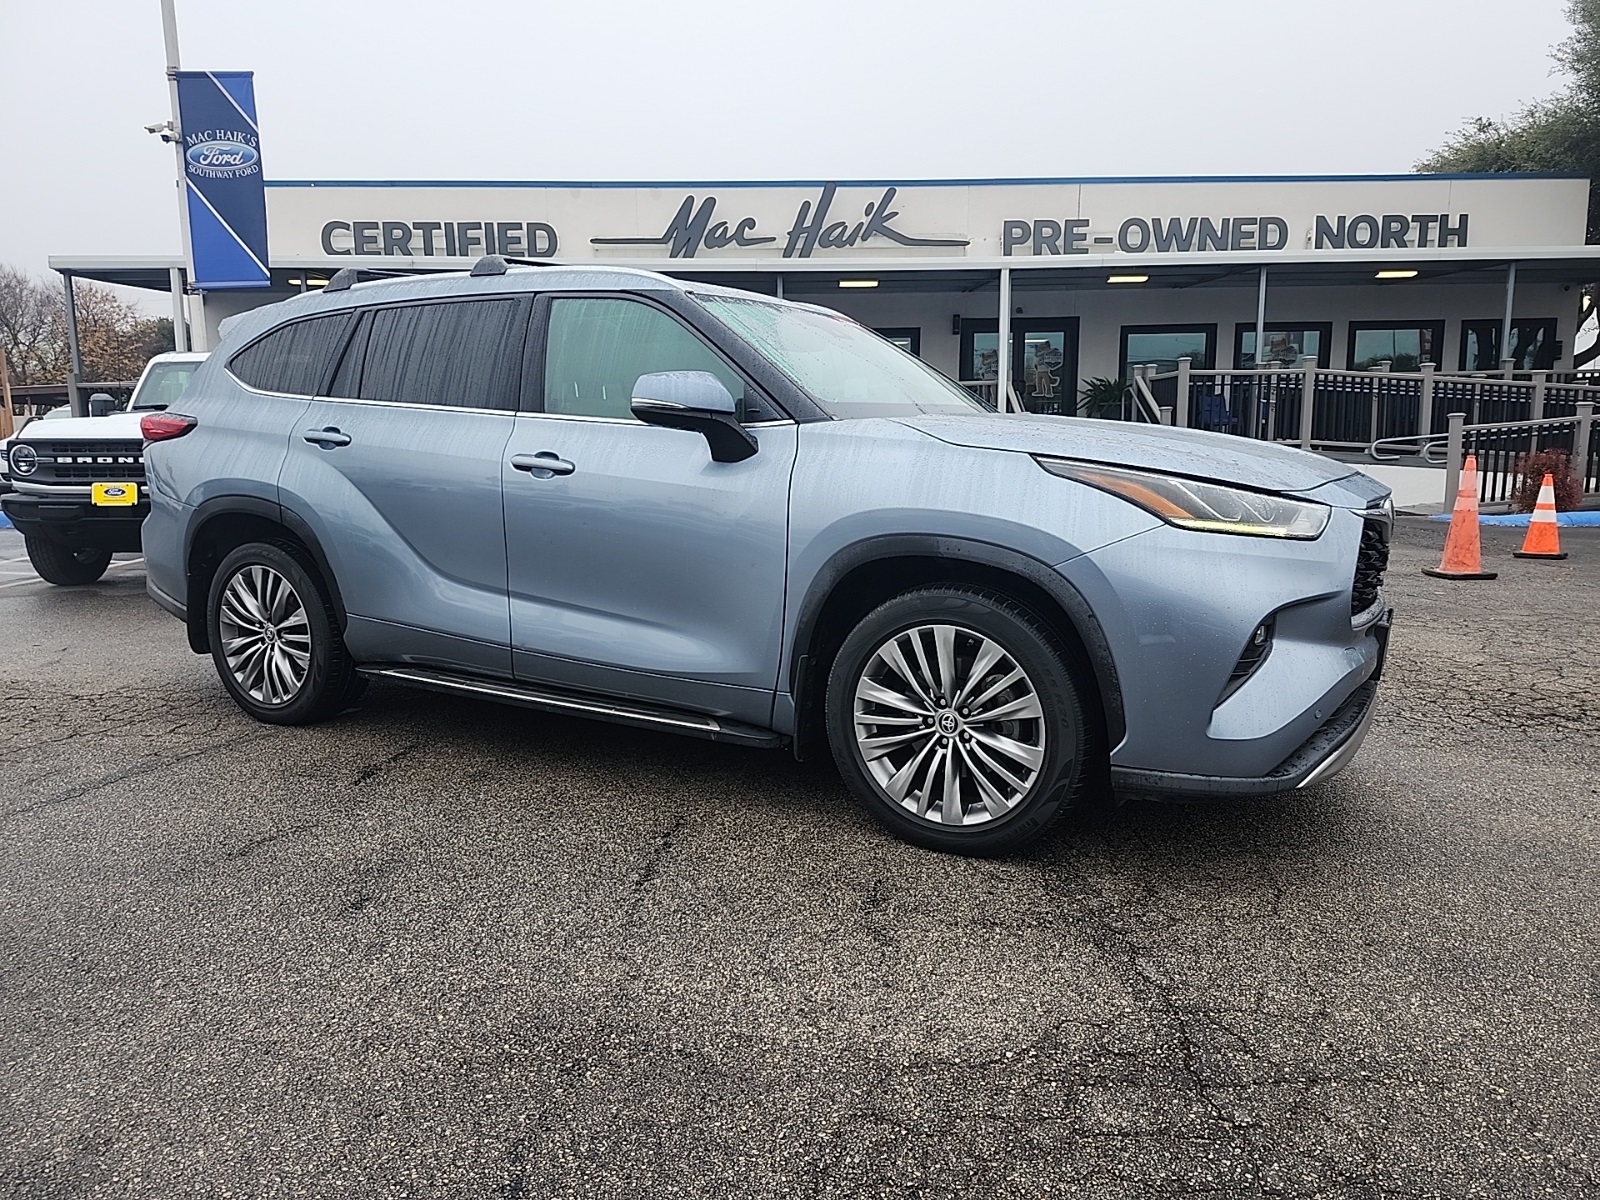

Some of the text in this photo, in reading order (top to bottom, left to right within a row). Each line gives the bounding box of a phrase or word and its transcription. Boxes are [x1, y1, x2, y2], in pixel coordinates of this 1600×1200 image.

[186, 130, 258, 147] MAC HAIK'S
[200, 146, 244, 165] Ford
[188, 164, 259, 179] SOUTHWAY FORD
[590, 181, 970, 258] Mac Haik
[321, 221, 558, 257] CERTIFIED
[1003, 213, 1469, 255] PRE-OWNED NORTH
